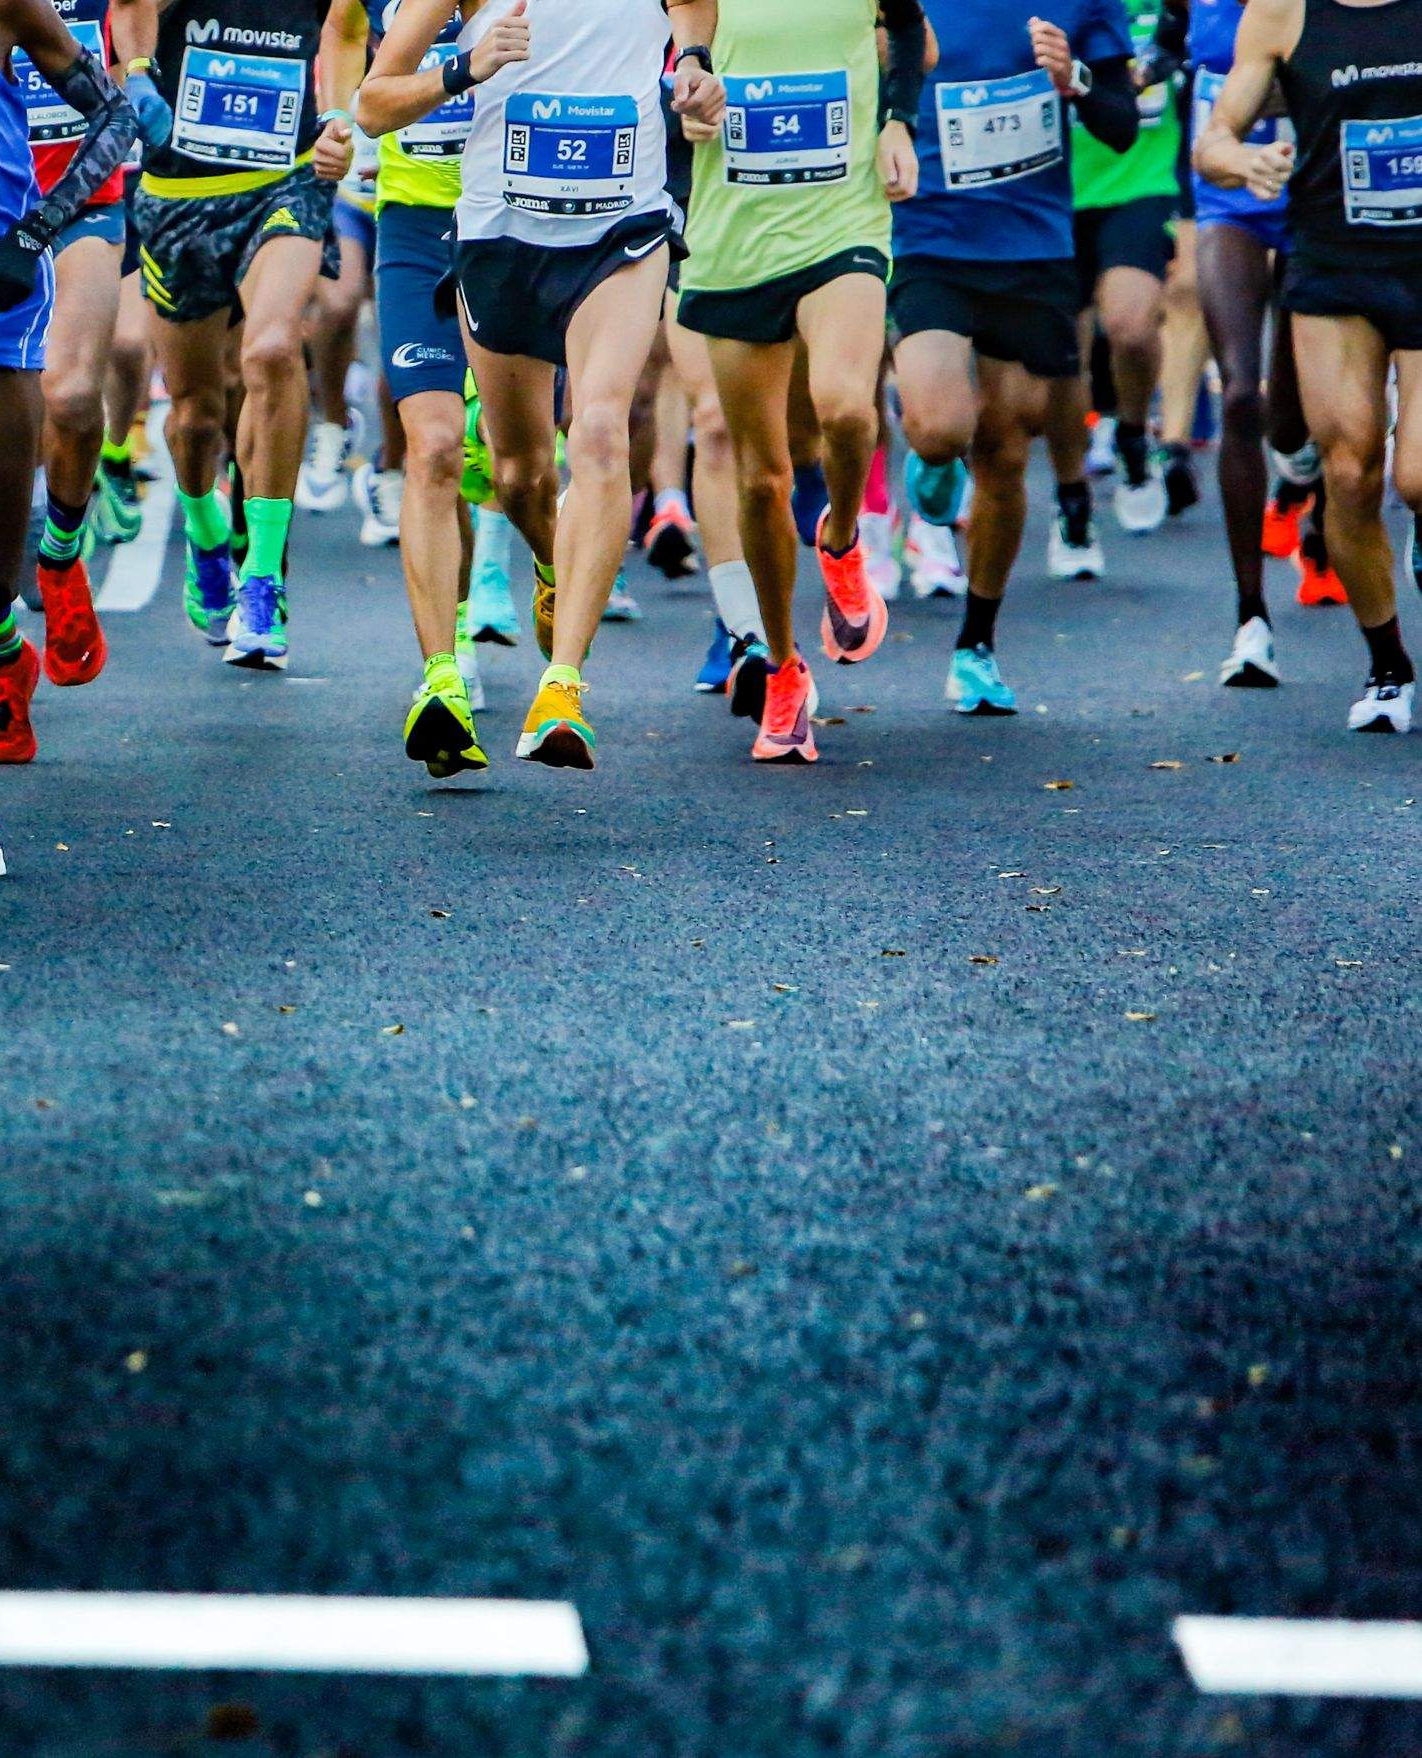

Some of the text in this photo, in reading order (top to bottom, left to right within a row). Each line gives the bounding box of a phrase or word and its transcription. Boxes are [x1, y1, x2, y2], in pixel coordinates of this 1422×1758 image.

[223, 27, 302, 49] movistar
[28, 71, 52, 90] 5
[222, 93, 259, 115] 151
[567, 105, 615, 116] Movistar
[772, 114, 801, 136] 54
[983, 114, 1022, 133] 473
[557, 139, 587, 161] 52
